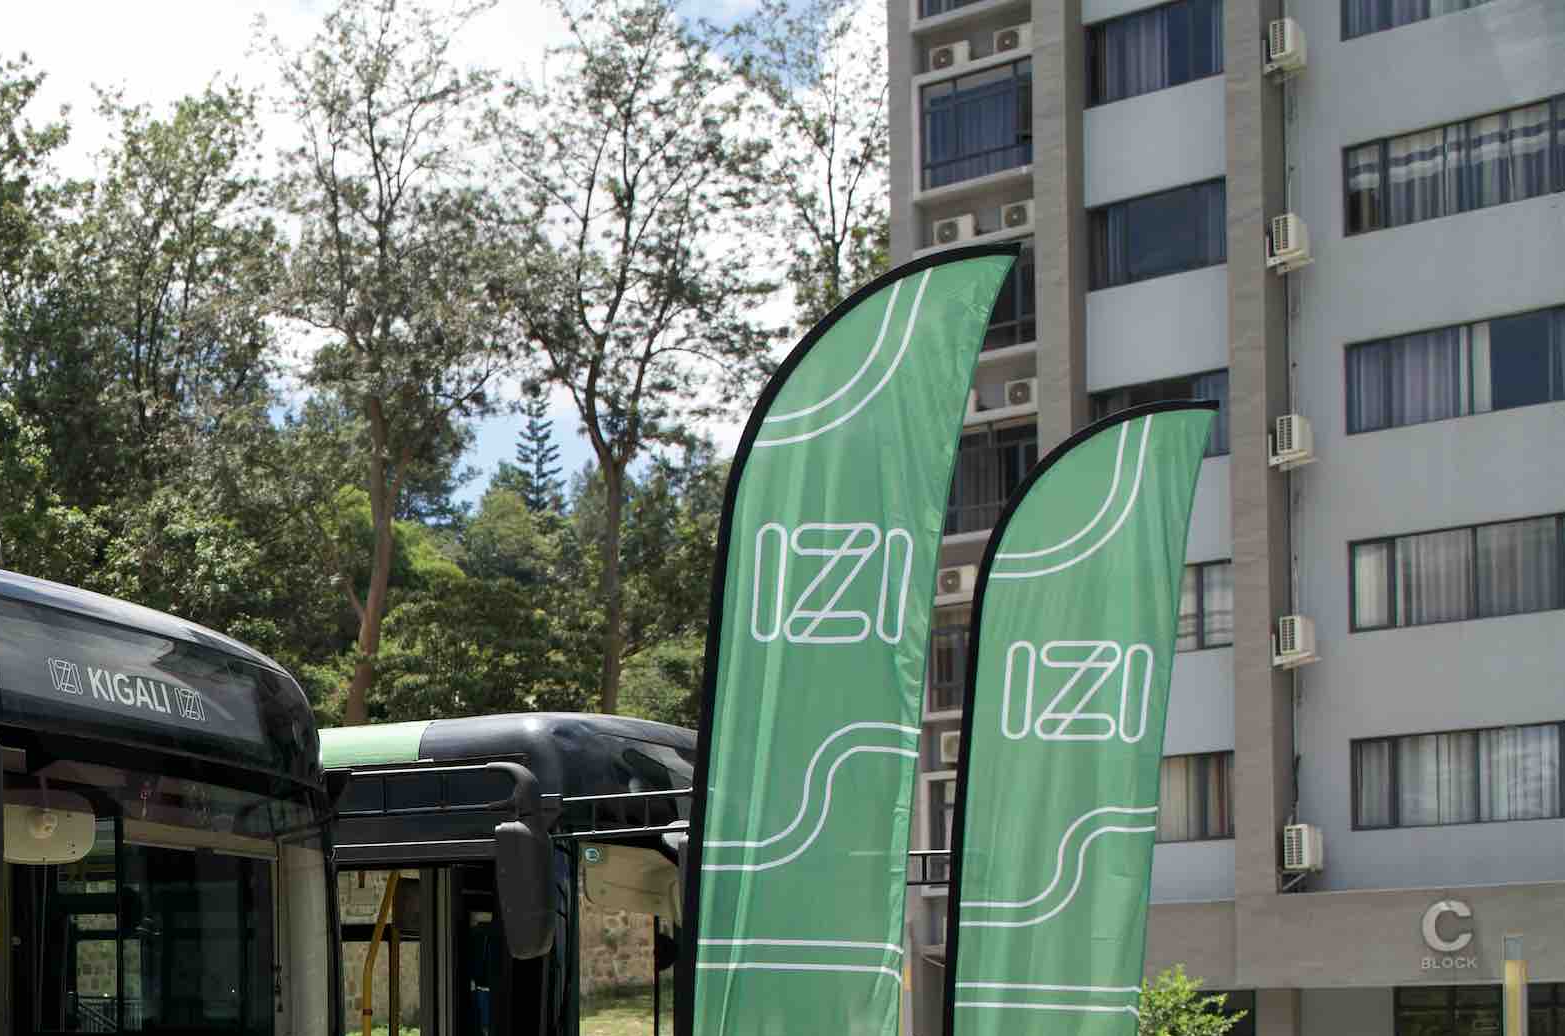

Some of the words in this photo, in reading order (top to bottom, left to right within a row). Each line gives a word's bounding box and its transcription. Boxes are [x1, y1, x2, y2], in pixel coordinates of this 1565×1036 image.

[750, 522, 913, 644] IZI
[87, 667, 171, 713] KIGALI
[1001, 640, 1153, 743] IZI
[1421, 900, 1472, 951] C
[1421, 957, 1476, 969] BLOCK
